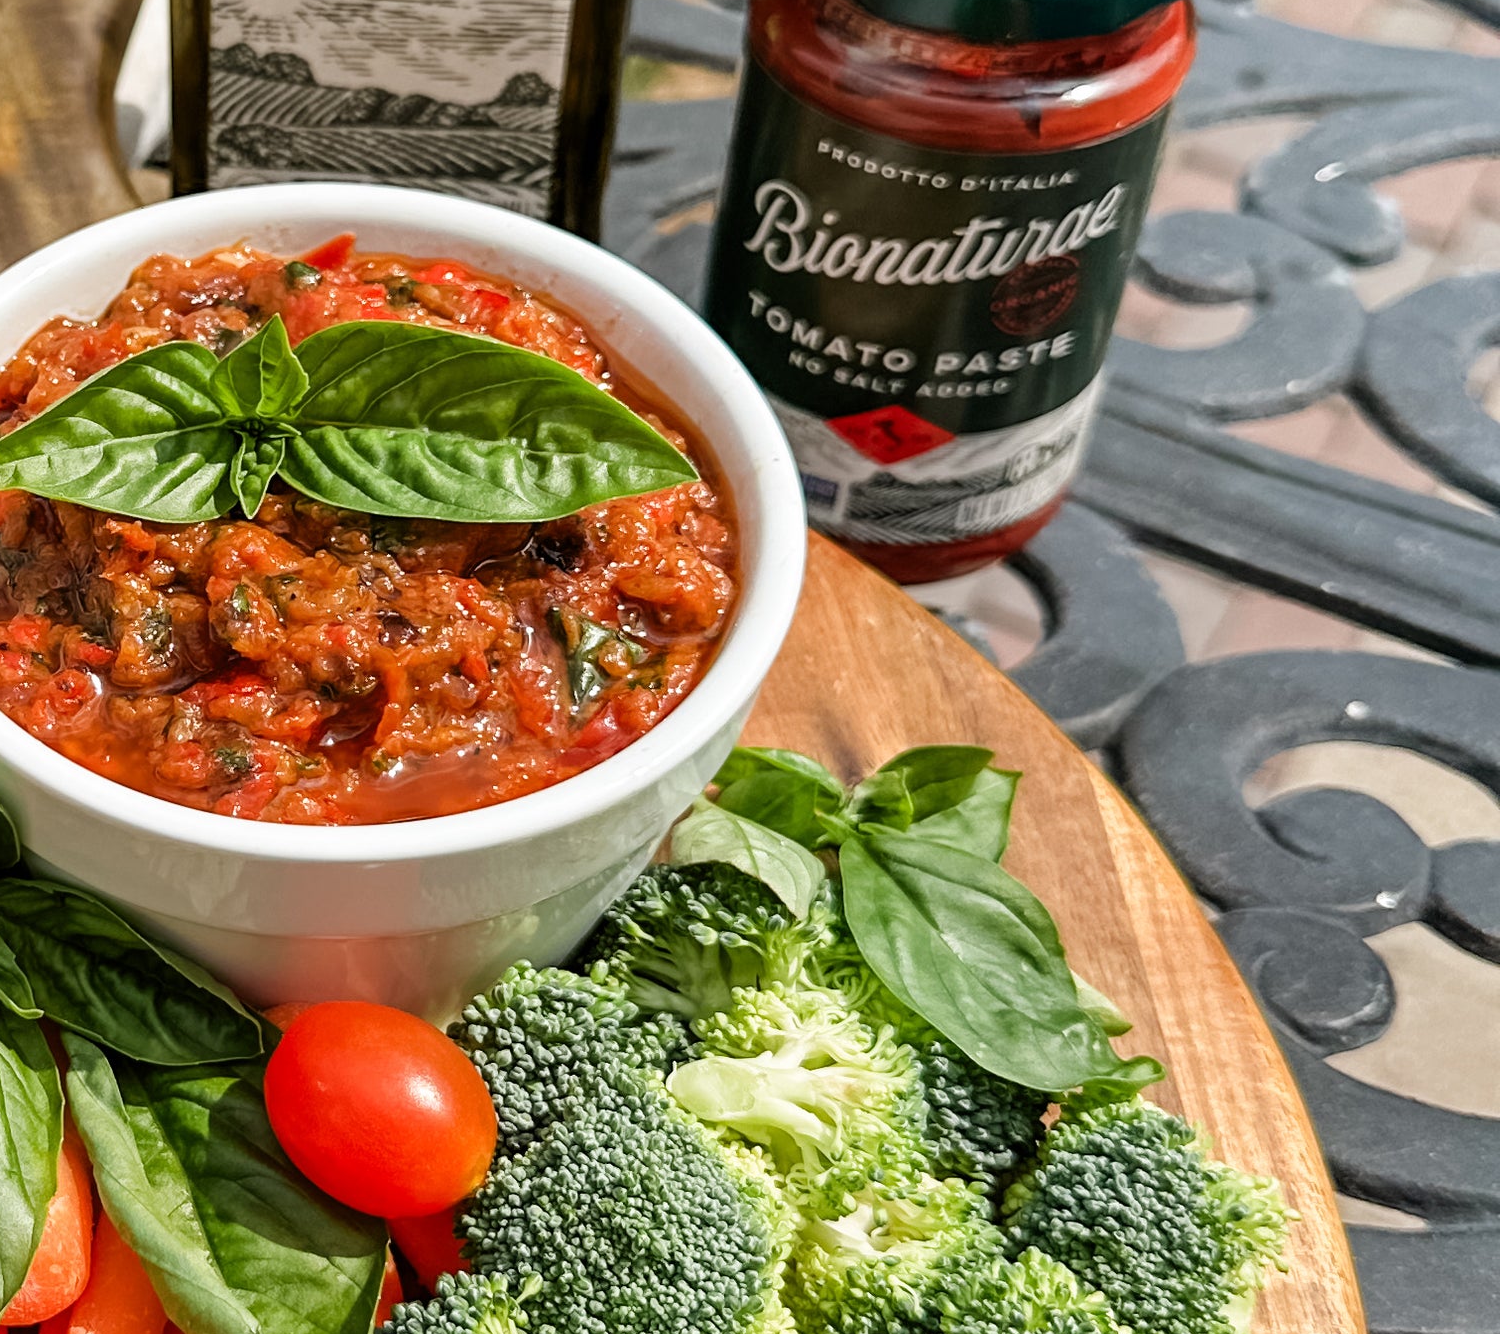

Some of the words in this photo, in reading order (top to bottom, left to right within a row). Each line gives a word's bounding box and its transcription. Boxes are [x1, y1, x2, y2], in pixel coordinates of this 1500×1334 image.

[817, 138, 950, 190] PRODOTTO
[961, 170, 1077, 191] D'ITALIA
[743, 180, 1124, 284] Bionaturae
[747, 292, 915, 371] TOMATO
[934, 330, 1078, 375] PASTE
[788, 349, 822, 375] NO
[833, 368, 906, 394] SALT
[915, 378, 1014, 399] ADDED
